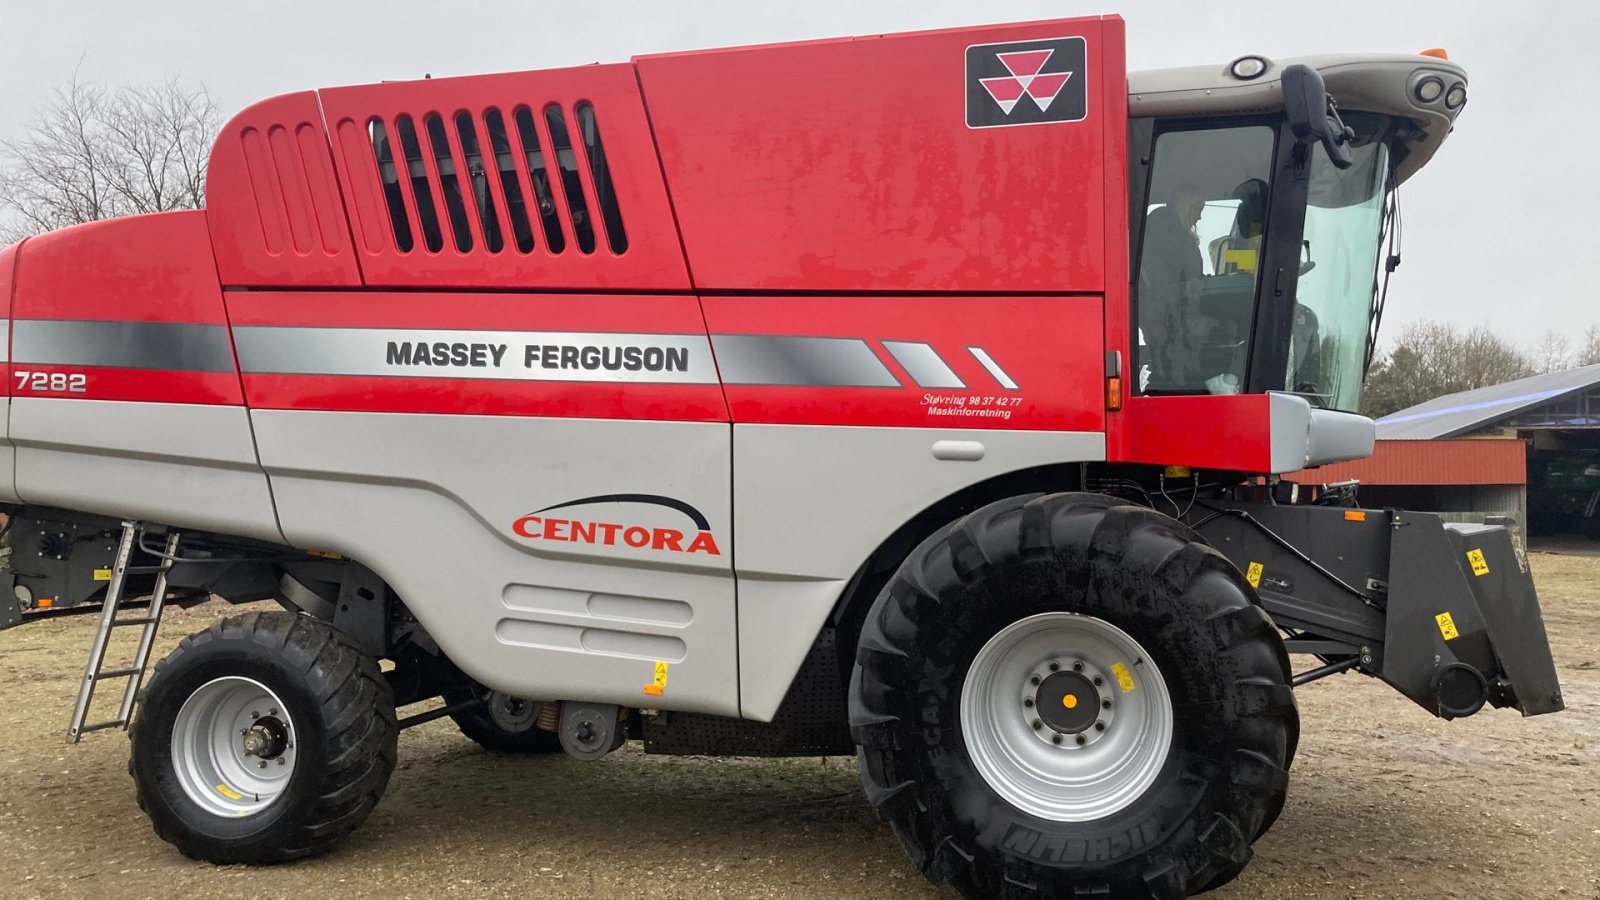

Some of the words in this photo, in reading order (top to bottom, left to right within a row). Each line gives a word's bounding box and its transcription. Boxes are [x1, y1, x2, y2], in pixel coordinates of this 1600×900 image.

[386, 341, 507, 368] MASSEY
[524, 345, 688, 372] FERGUSON
[14, 371, 87, 392] 7282
[920, 393, 967, 408] Støvring
[968, 395, 980, 406] 98
[982, 396, 995, 406] 37
[995, 397, 1008, 406] 42
[1009, 397, 1022, 407] 77
[927, 406, 1011, 419] Maskinforretning
[512, 516, 720, 555] CENTORA
